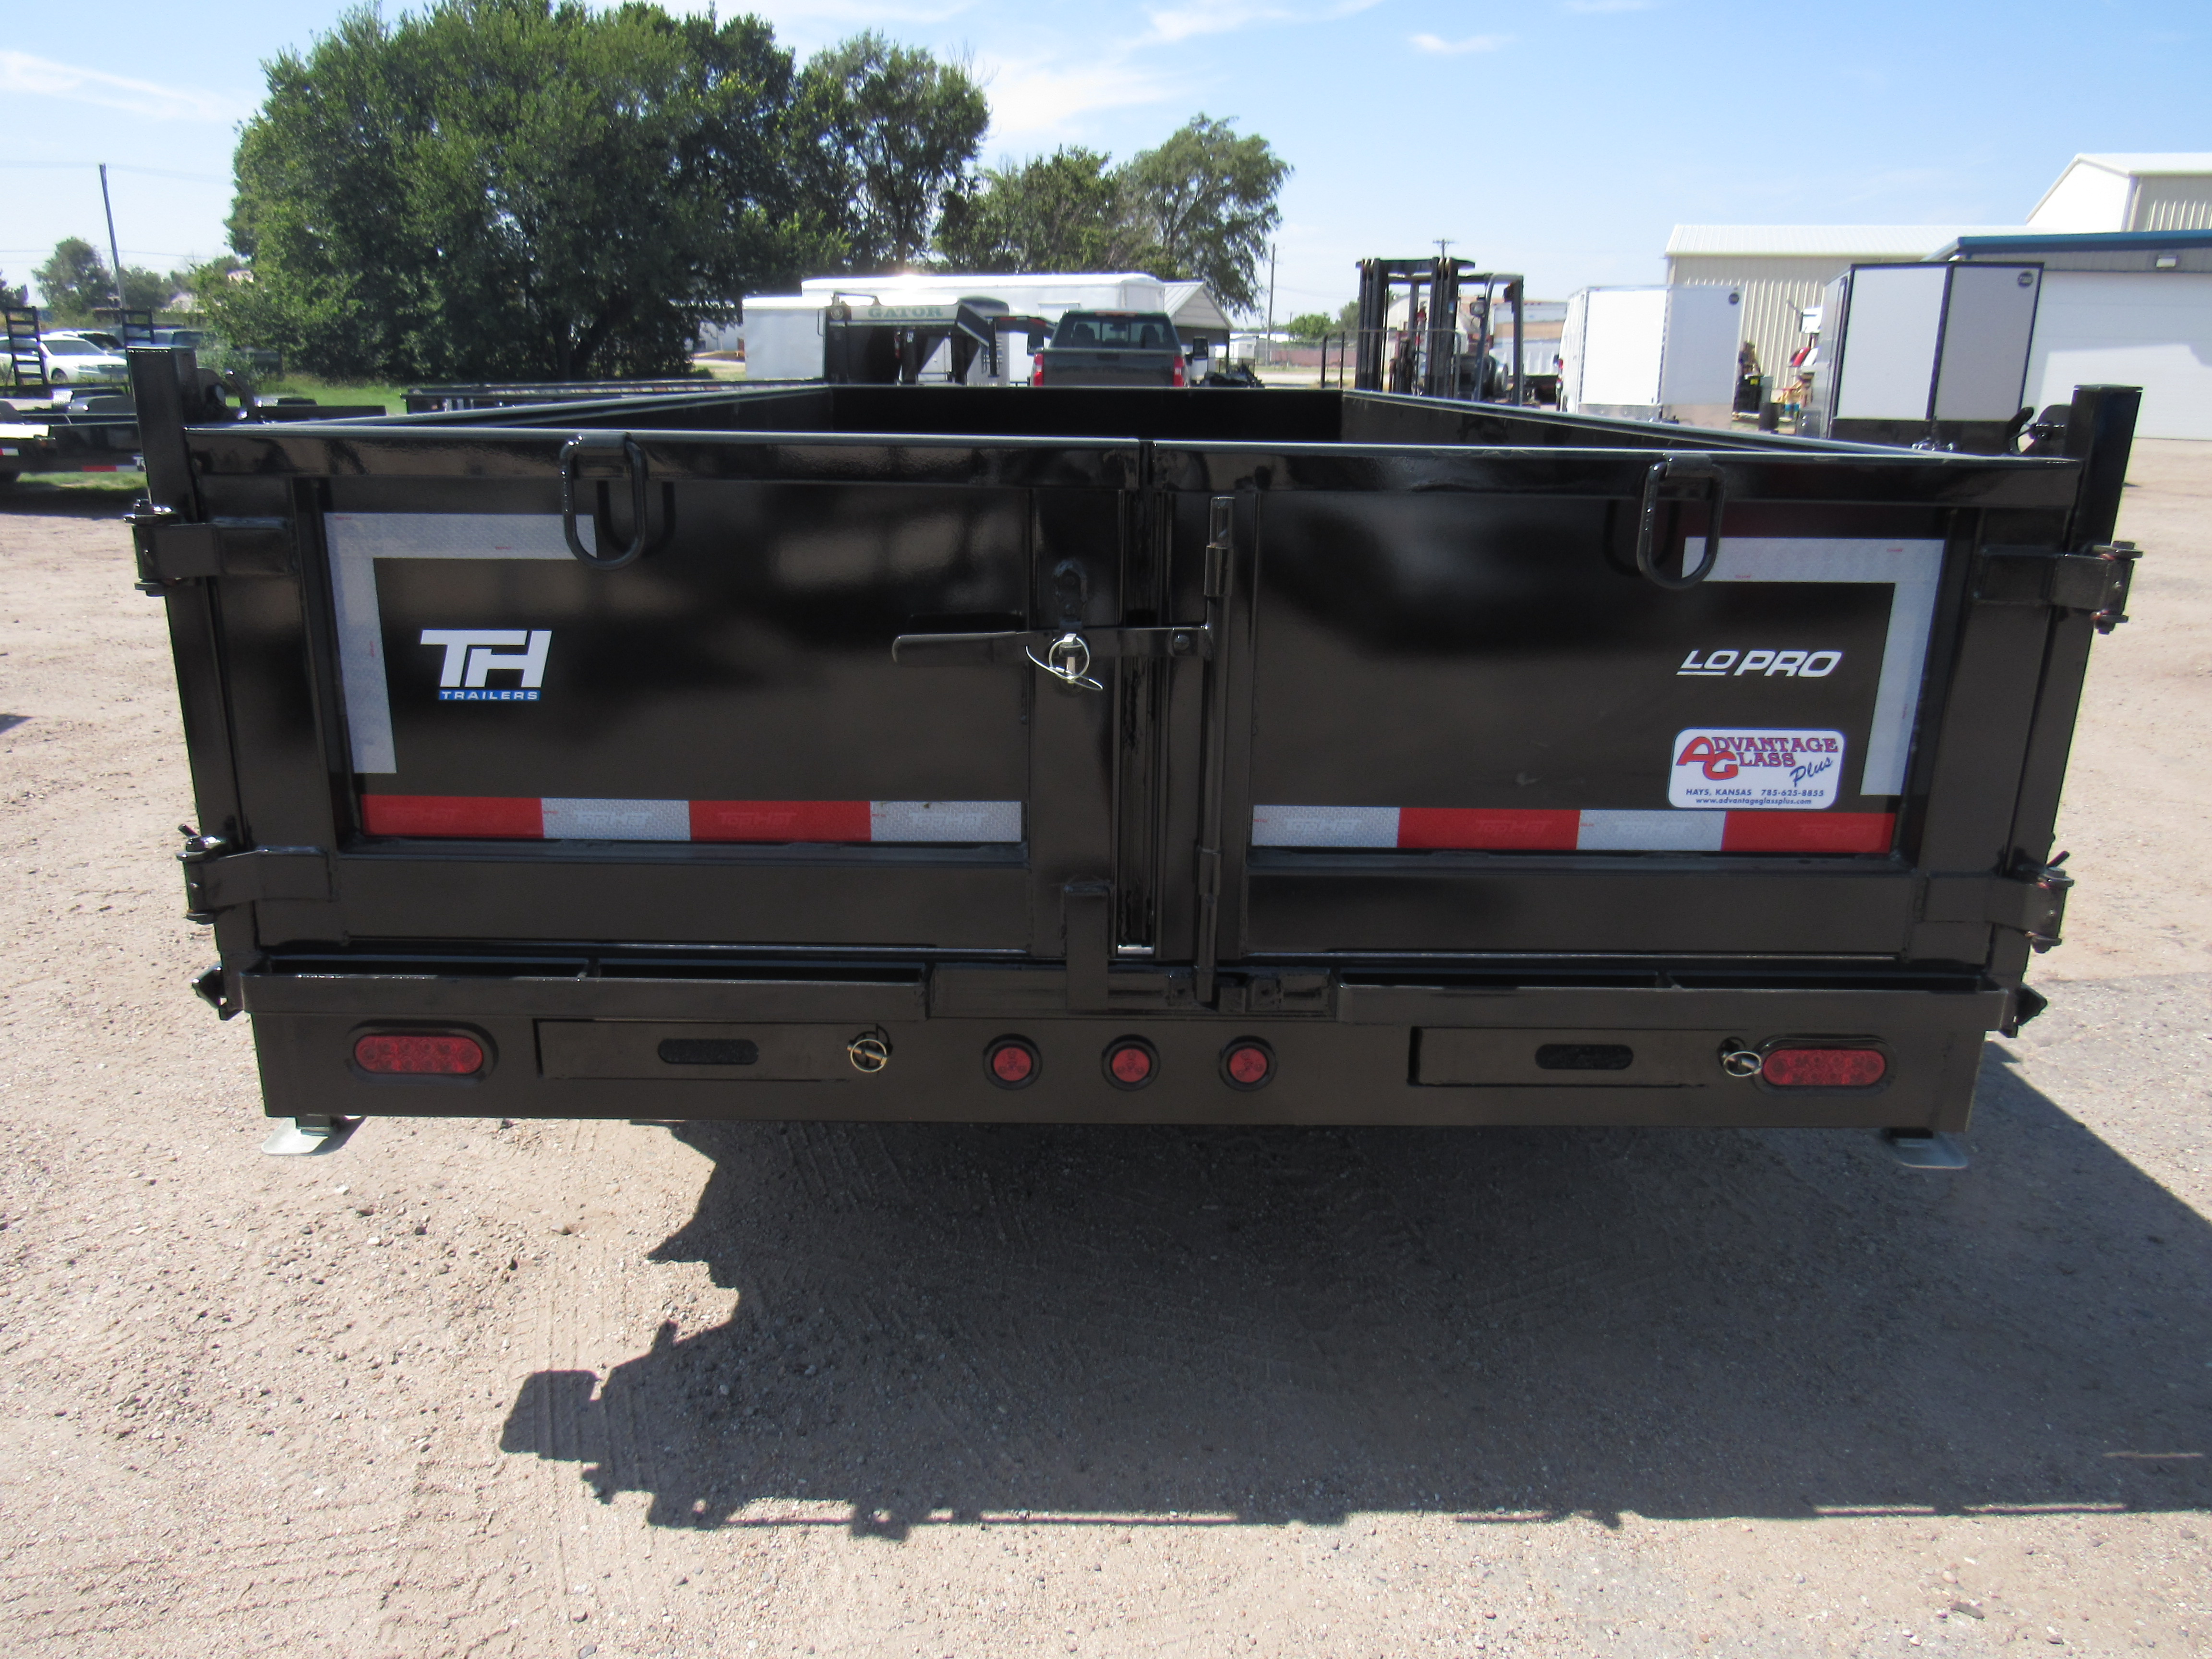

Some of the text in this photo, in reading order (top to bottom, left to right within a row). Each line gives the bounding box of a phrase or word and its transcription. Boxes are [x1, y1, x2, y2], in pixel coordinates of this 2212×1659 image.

[868, 307, 943, 318] GATOR
[421, 629, 552, 688] TH
[1681, 649, 1843, 677] LO PRO
[442, 691, 539, 700] TRAILERS
[1676, 736, 1839, 766] ADVANTAGE
[1703, 751, 1796, 781] GLASS
[1789, 757, 1833, 787] Plus
[1696, 797, 1811, 805] www.advantageglassplus.com
